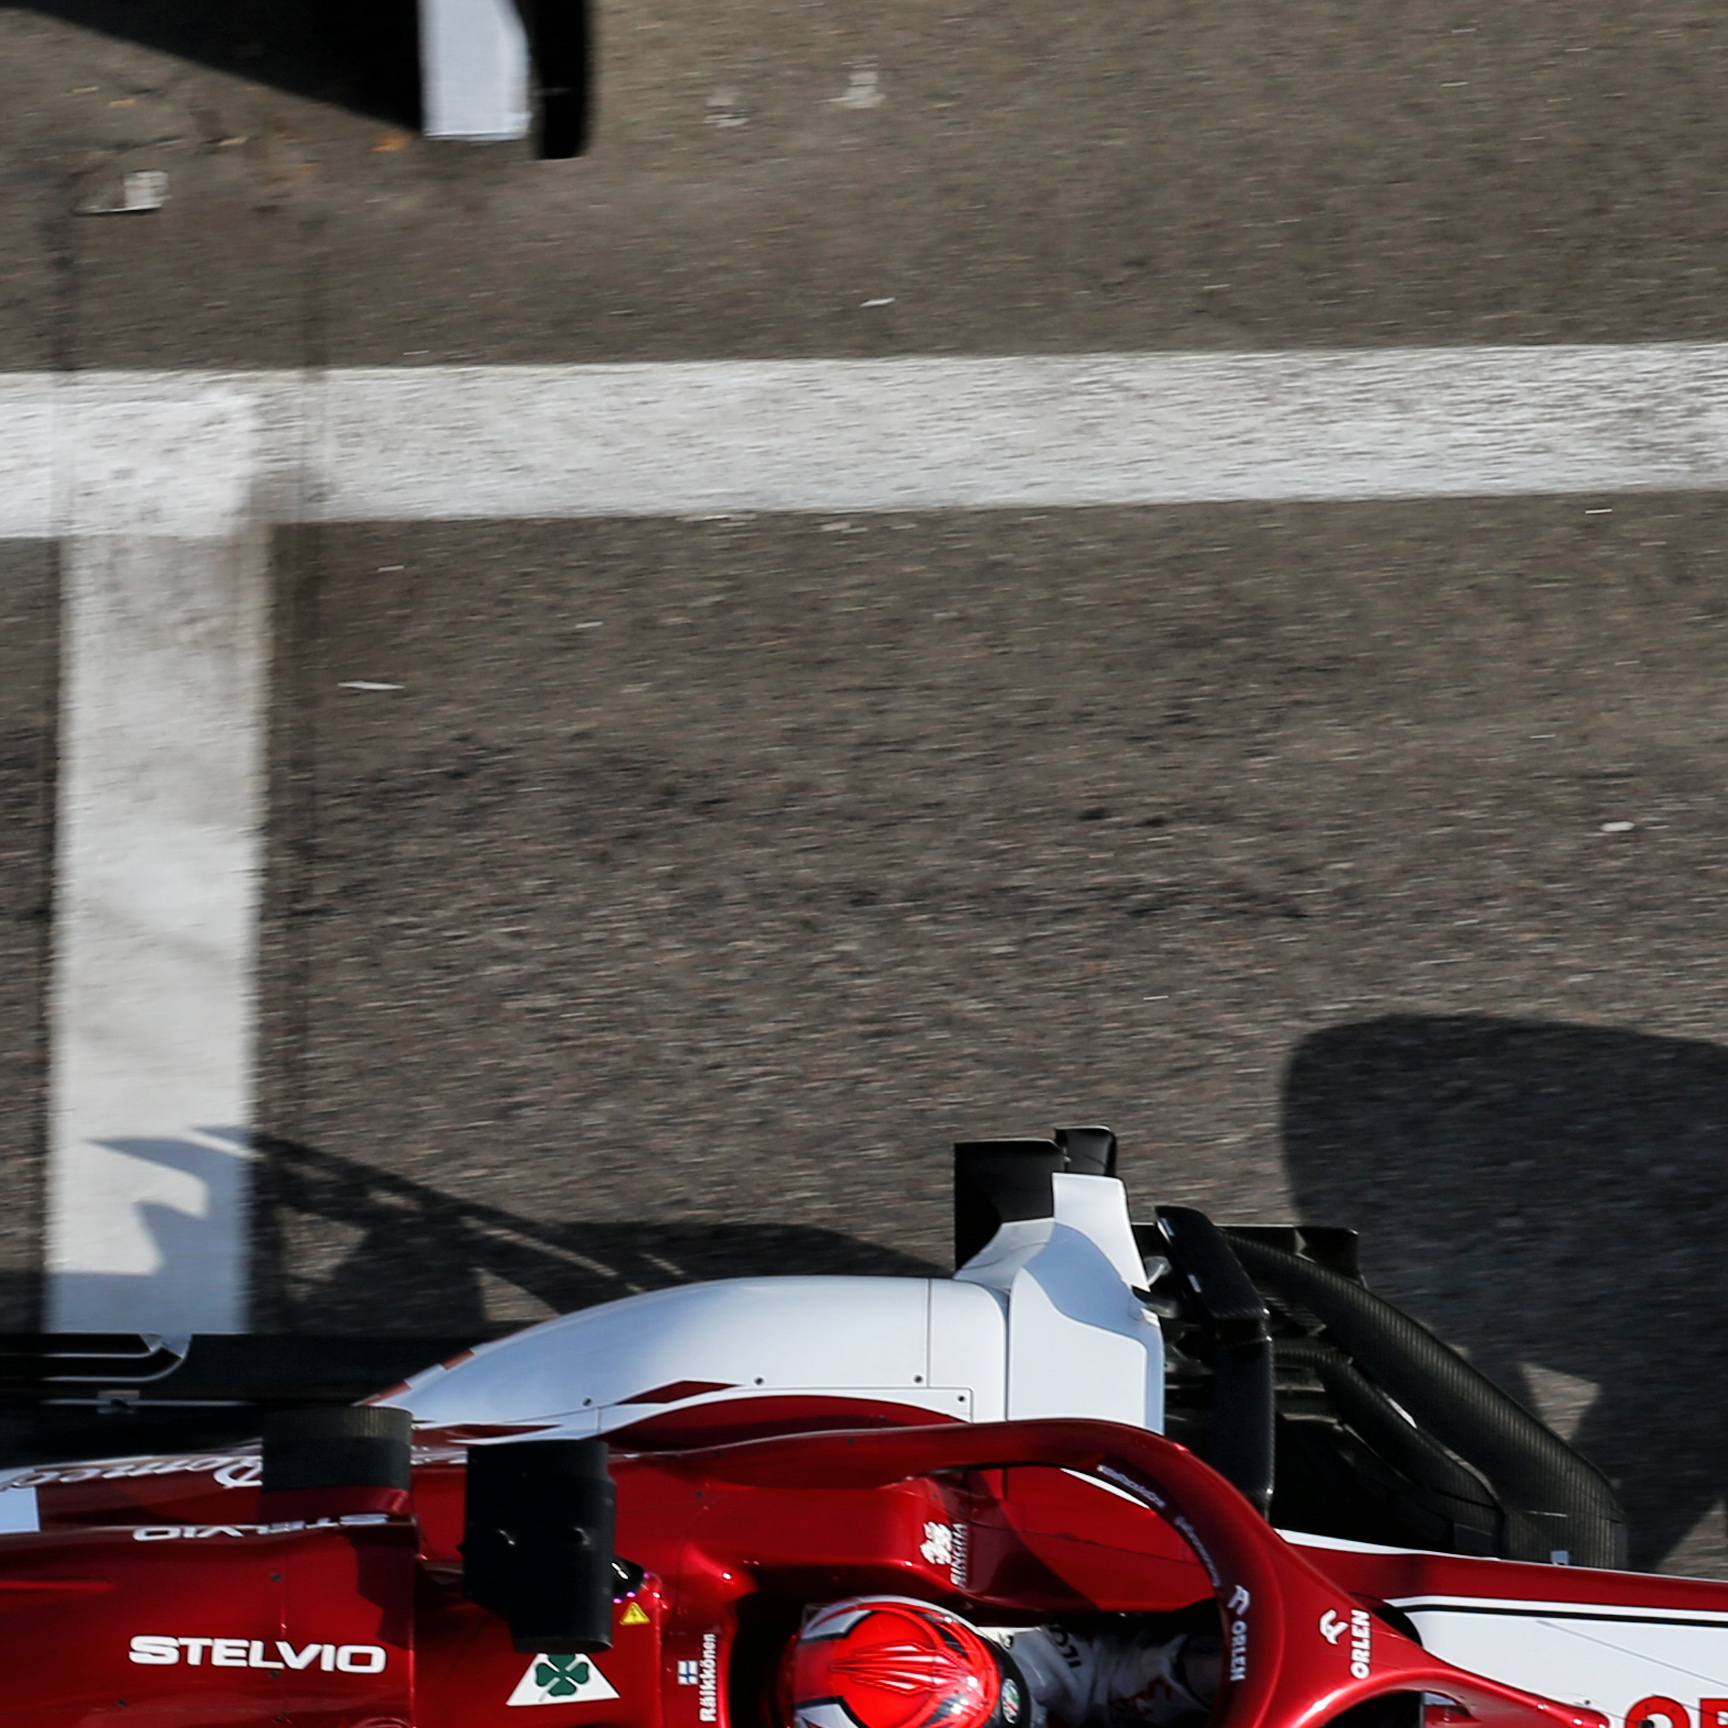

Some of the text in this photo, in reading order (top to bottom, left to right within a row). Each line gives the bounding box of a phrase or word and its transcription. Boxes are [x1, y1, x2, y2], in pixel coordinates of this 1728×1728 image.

[129, 1635, 386, 1673] STELVIO
[1230, 1620, 1247, 1681] ORLEN
[1351, 1609, 1371, 1679] ORLEN
